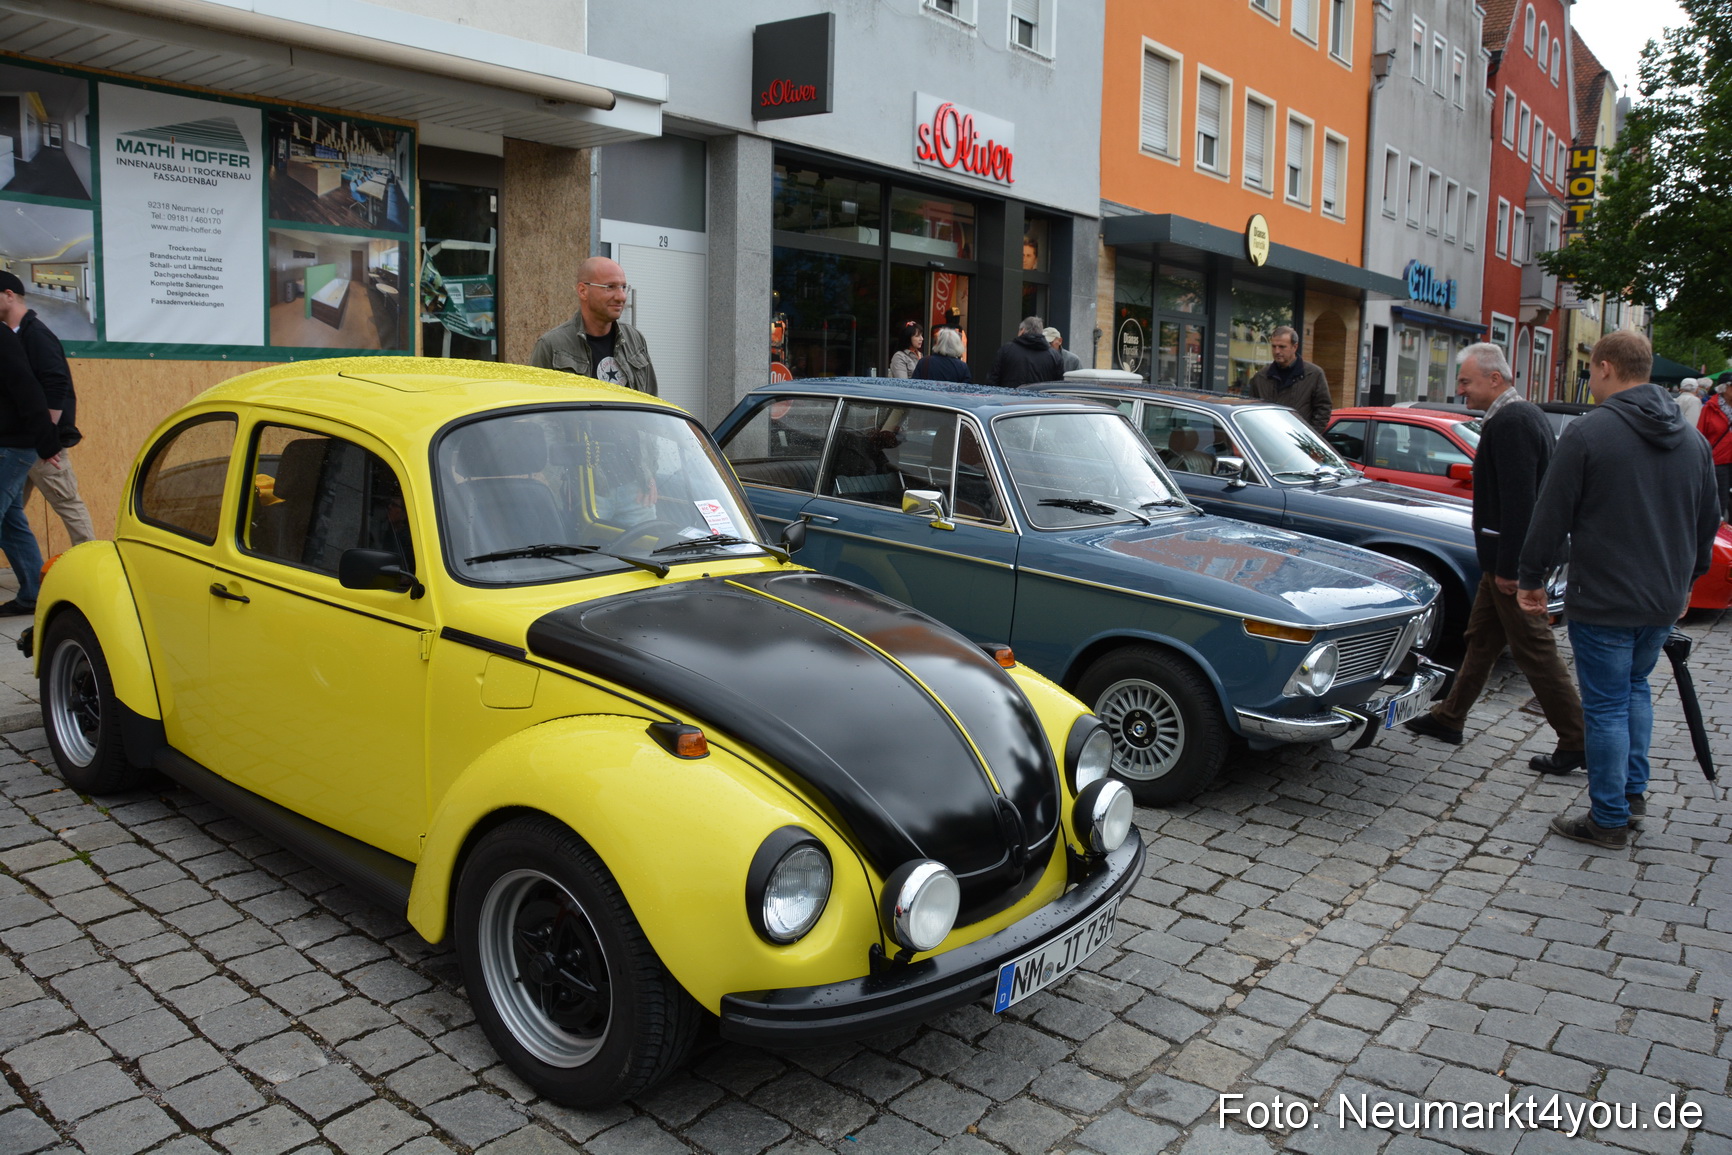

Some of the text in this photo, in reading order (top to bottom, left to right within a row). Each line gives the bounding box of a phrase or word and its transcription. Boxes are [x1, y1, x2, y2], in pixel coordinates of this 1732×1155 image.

[760, 78, 817, 106] s.Oliver
[916, 101, 1016, 184] s.Oliver
[181, 147, 251, 169] HOFFER
[115, 157, 186, 174] INNENAUSBAU
[193, 167, 252, 181] TROCKENBAU
[153, 172, 218, 187] FASSADENBAU
[147, 201, 170, 211] 92318
[171, 203, 205, 214] Neumarkt
[210, 207, 224, 216] Opf
[167, 213, 189, 222] 09181
[150, 223, 222, 235] www.mathi-hoffer.de
[659, 235, 669, 248] 29
[168, 244, 207, 253] Trockenbau
[149, 252, 191, 261] Brandschutz
[149, 261, 172, 269] Schall-
[188, 264, 223, 272] Lärmschutz
[150, 280, 224, 290] Komplette Sanierungen
[166, 289, 210, 298] Designdecken
[150, 298, 225, 308] Fassadenverkleidungen
[1011, 902, 1118, 1000] NM JT 73H
[999, 992, 1006, 1004] D
